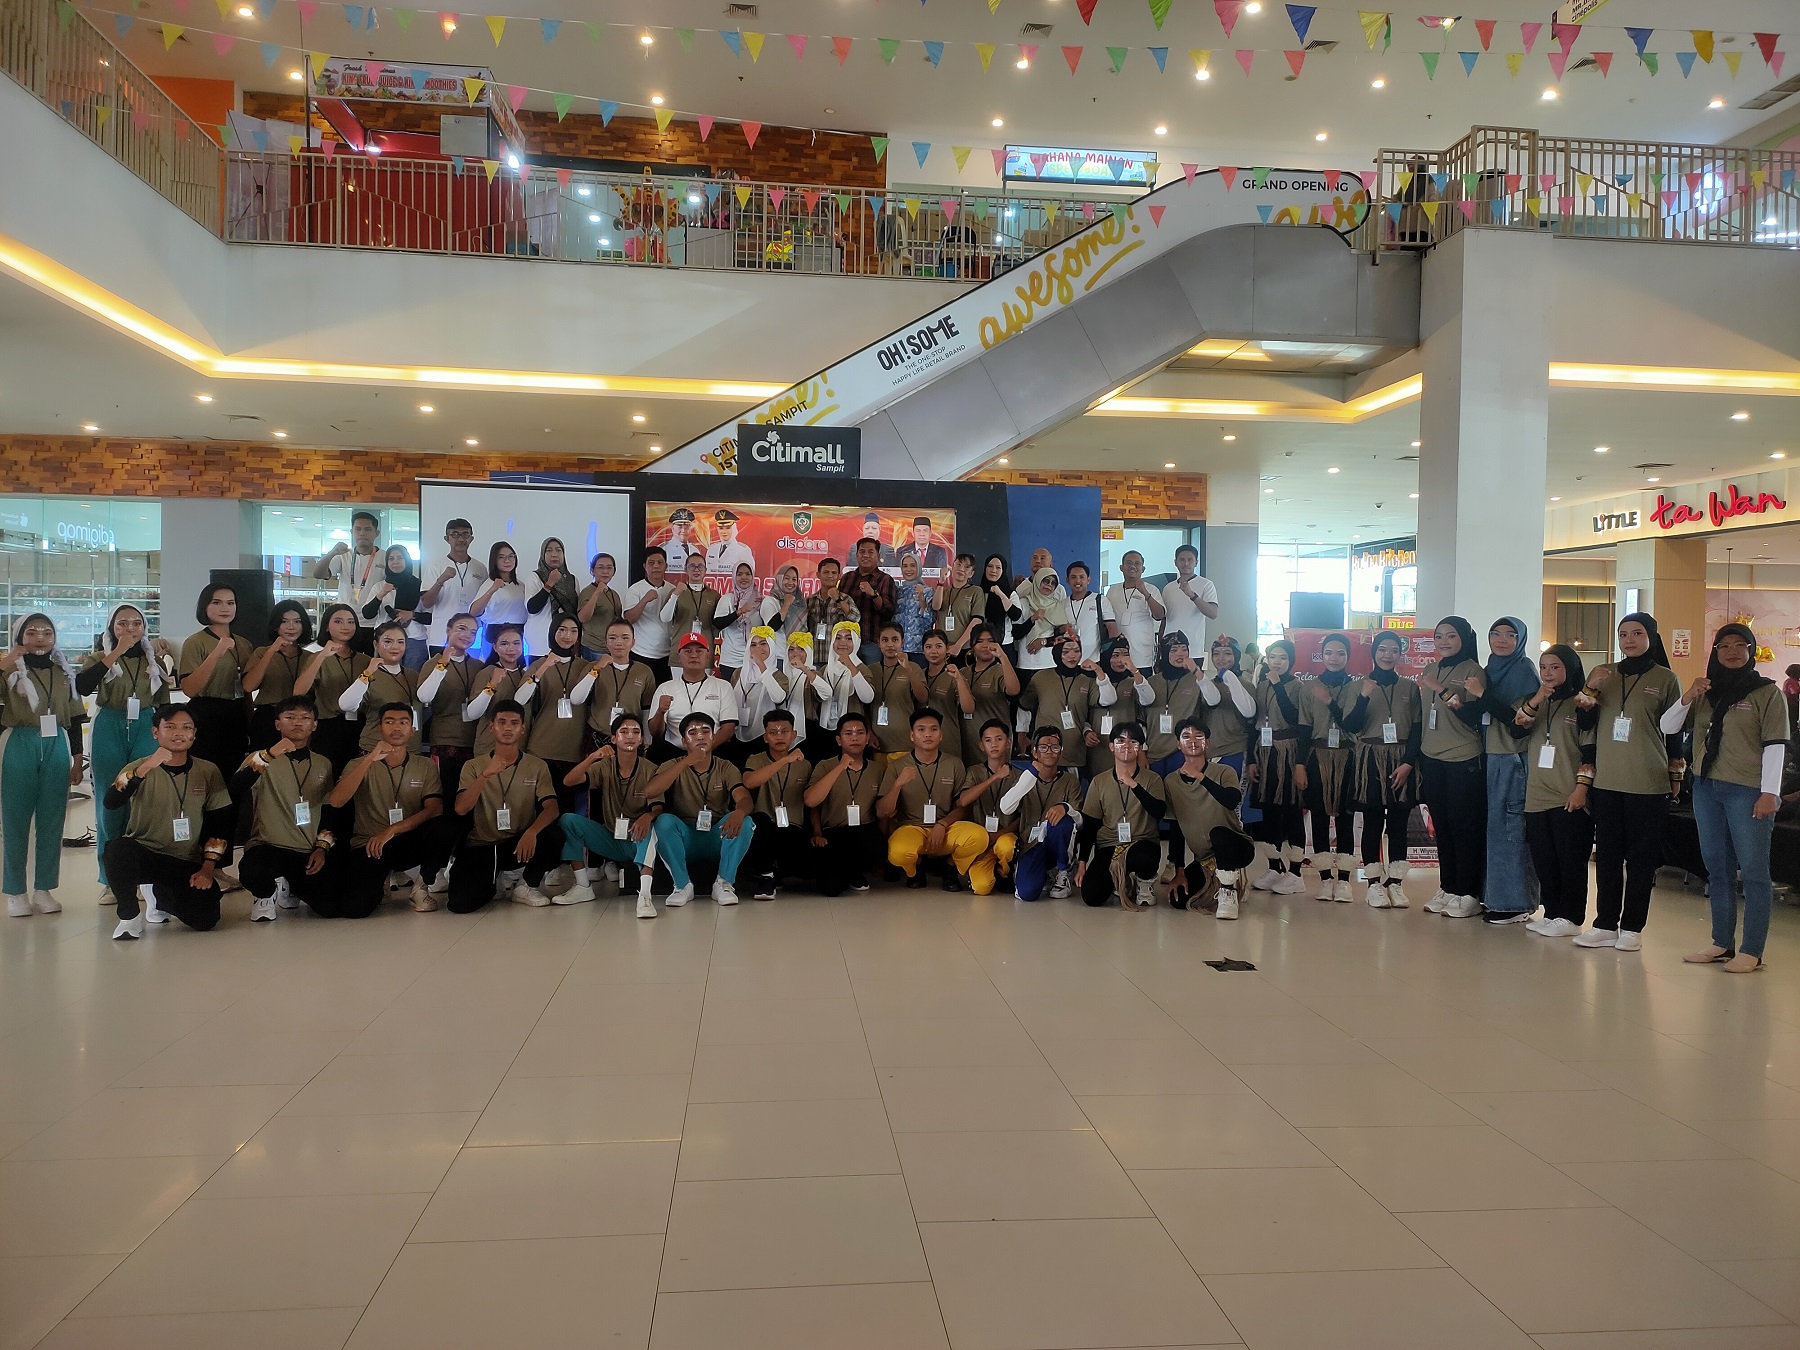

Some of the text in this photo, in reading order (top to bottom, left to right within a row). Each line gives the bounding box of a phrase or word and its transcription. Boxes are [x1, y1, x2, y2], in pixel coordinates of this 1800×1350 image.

[359, 74, 377, 87] FRU
[379, 75, 397, 88] JUICE
[423, 78, 457, 91] MOOTHIES
[1049, 163, 1112, 176] SPEDBOA
[1242, 180, 1349, 192] GRAND OPENING
[877, 314, 960, 371] OH!SOME
[892, 344, 966, 386] HAPPY LIFE RETAIL BRAND
[905, 346, 946, 371] THE ONE-STOP
[765, 400, 808, 425] SAMPIT
[751, 440, 845, 463] Citimall
[815, 463, 845, 474] Sampit
[1593, 511, 1638, 533] LITTLE
[1650, 495, 1704, 530] ta
